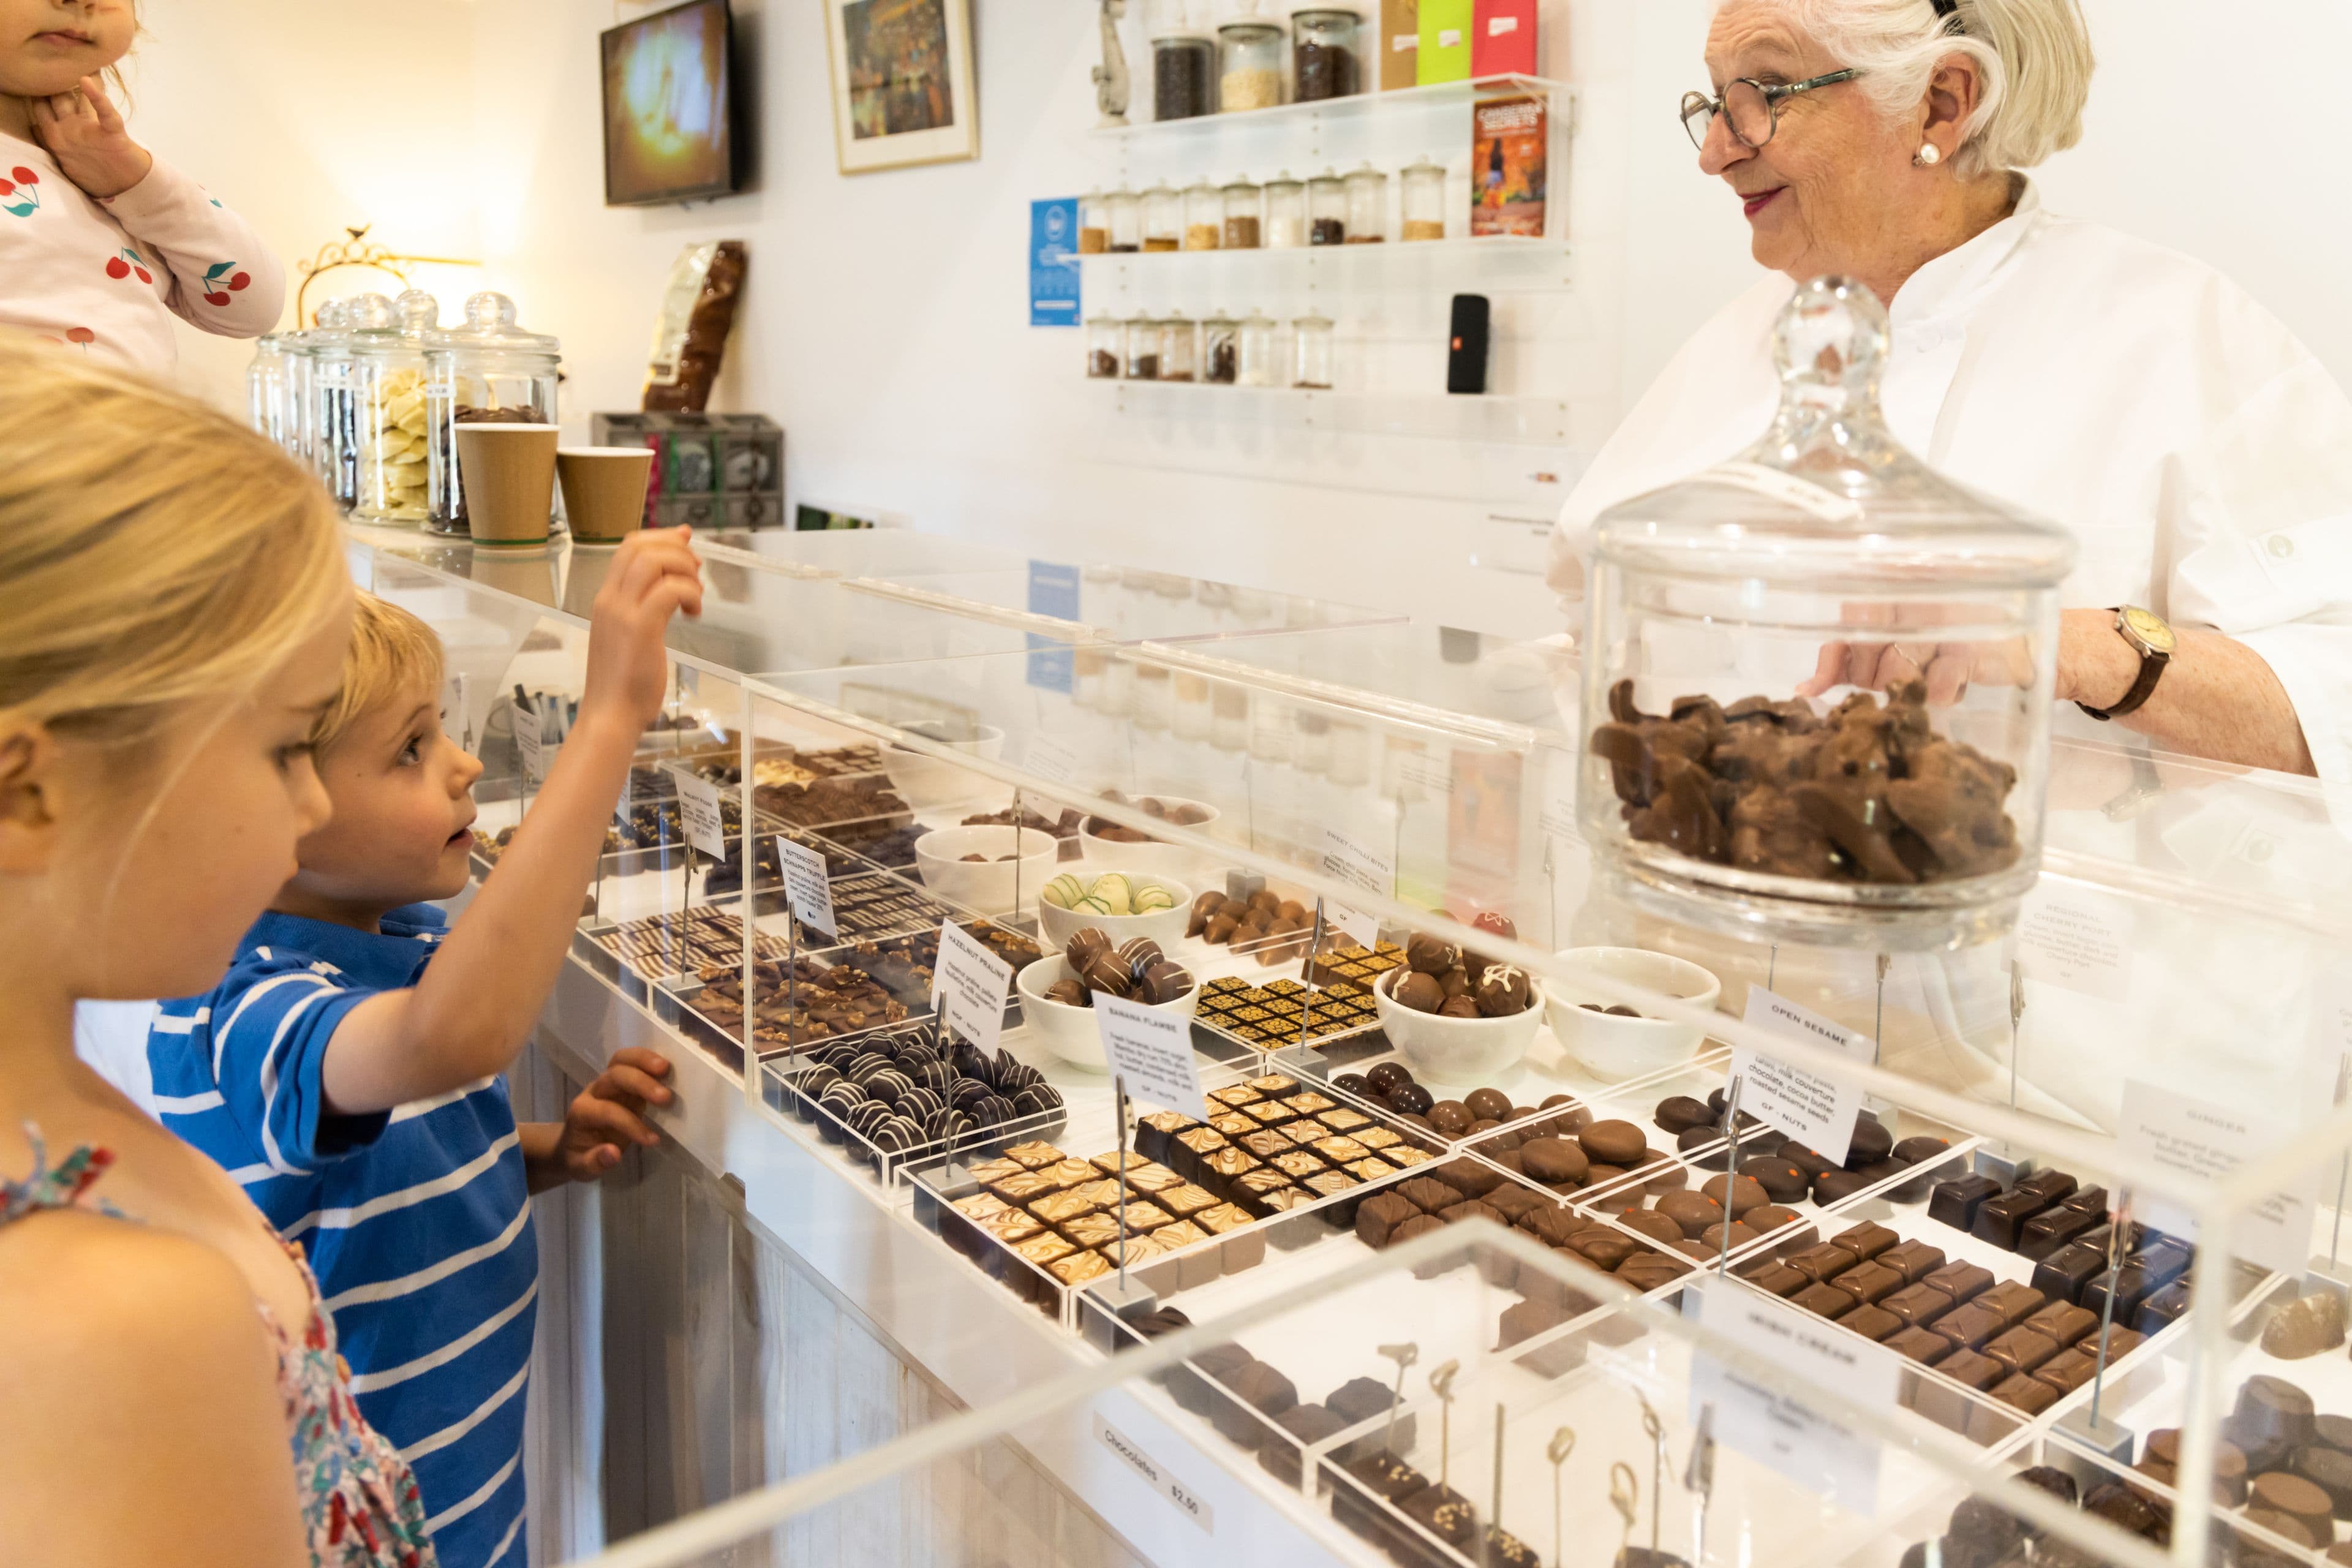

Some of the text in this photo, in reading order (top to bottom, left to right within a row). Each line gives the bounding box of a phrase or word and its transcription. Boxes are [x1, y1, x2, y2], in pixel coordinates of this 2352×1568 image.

[785, 849, 820, 869] BUTTERSCOTCH
[1327, 831, 1389, 872] SWEET CHILLI BITES
[783, 858, 826, 882] SCHNAPPS TRUFFLE
[2034, 912, 2112, 937] CHERRY PORT
[2045, 903, 2103, 924] REGIONAL
[948, 933, 1005, 981] HAZELNUT PRALINE
[2046, 951, 2090, 968] Cherry Port
[1109, 1006, 1141, 1022] BANANA
[1771, 1004, 1847, 1047] OPEN SESAME
[1749, 1063, 1836, 1117] chocolate, cocoa butter,
[1778, 1068, 1793, 1080] milk
[1795, 1077, 1835, 1103] couverture
[1749, 1076, 1830, 1124] roasted sesame seeds
[1762, 1102, 1774, 1111] GF
[1782, 1113, 1807, 1131] NUTS
[2186, 1109, 2246, 1134] GINGER
[2139, 1123, 2168, 1139] Fresh
[1104, 1430, 1158, 1481] Chocolates
